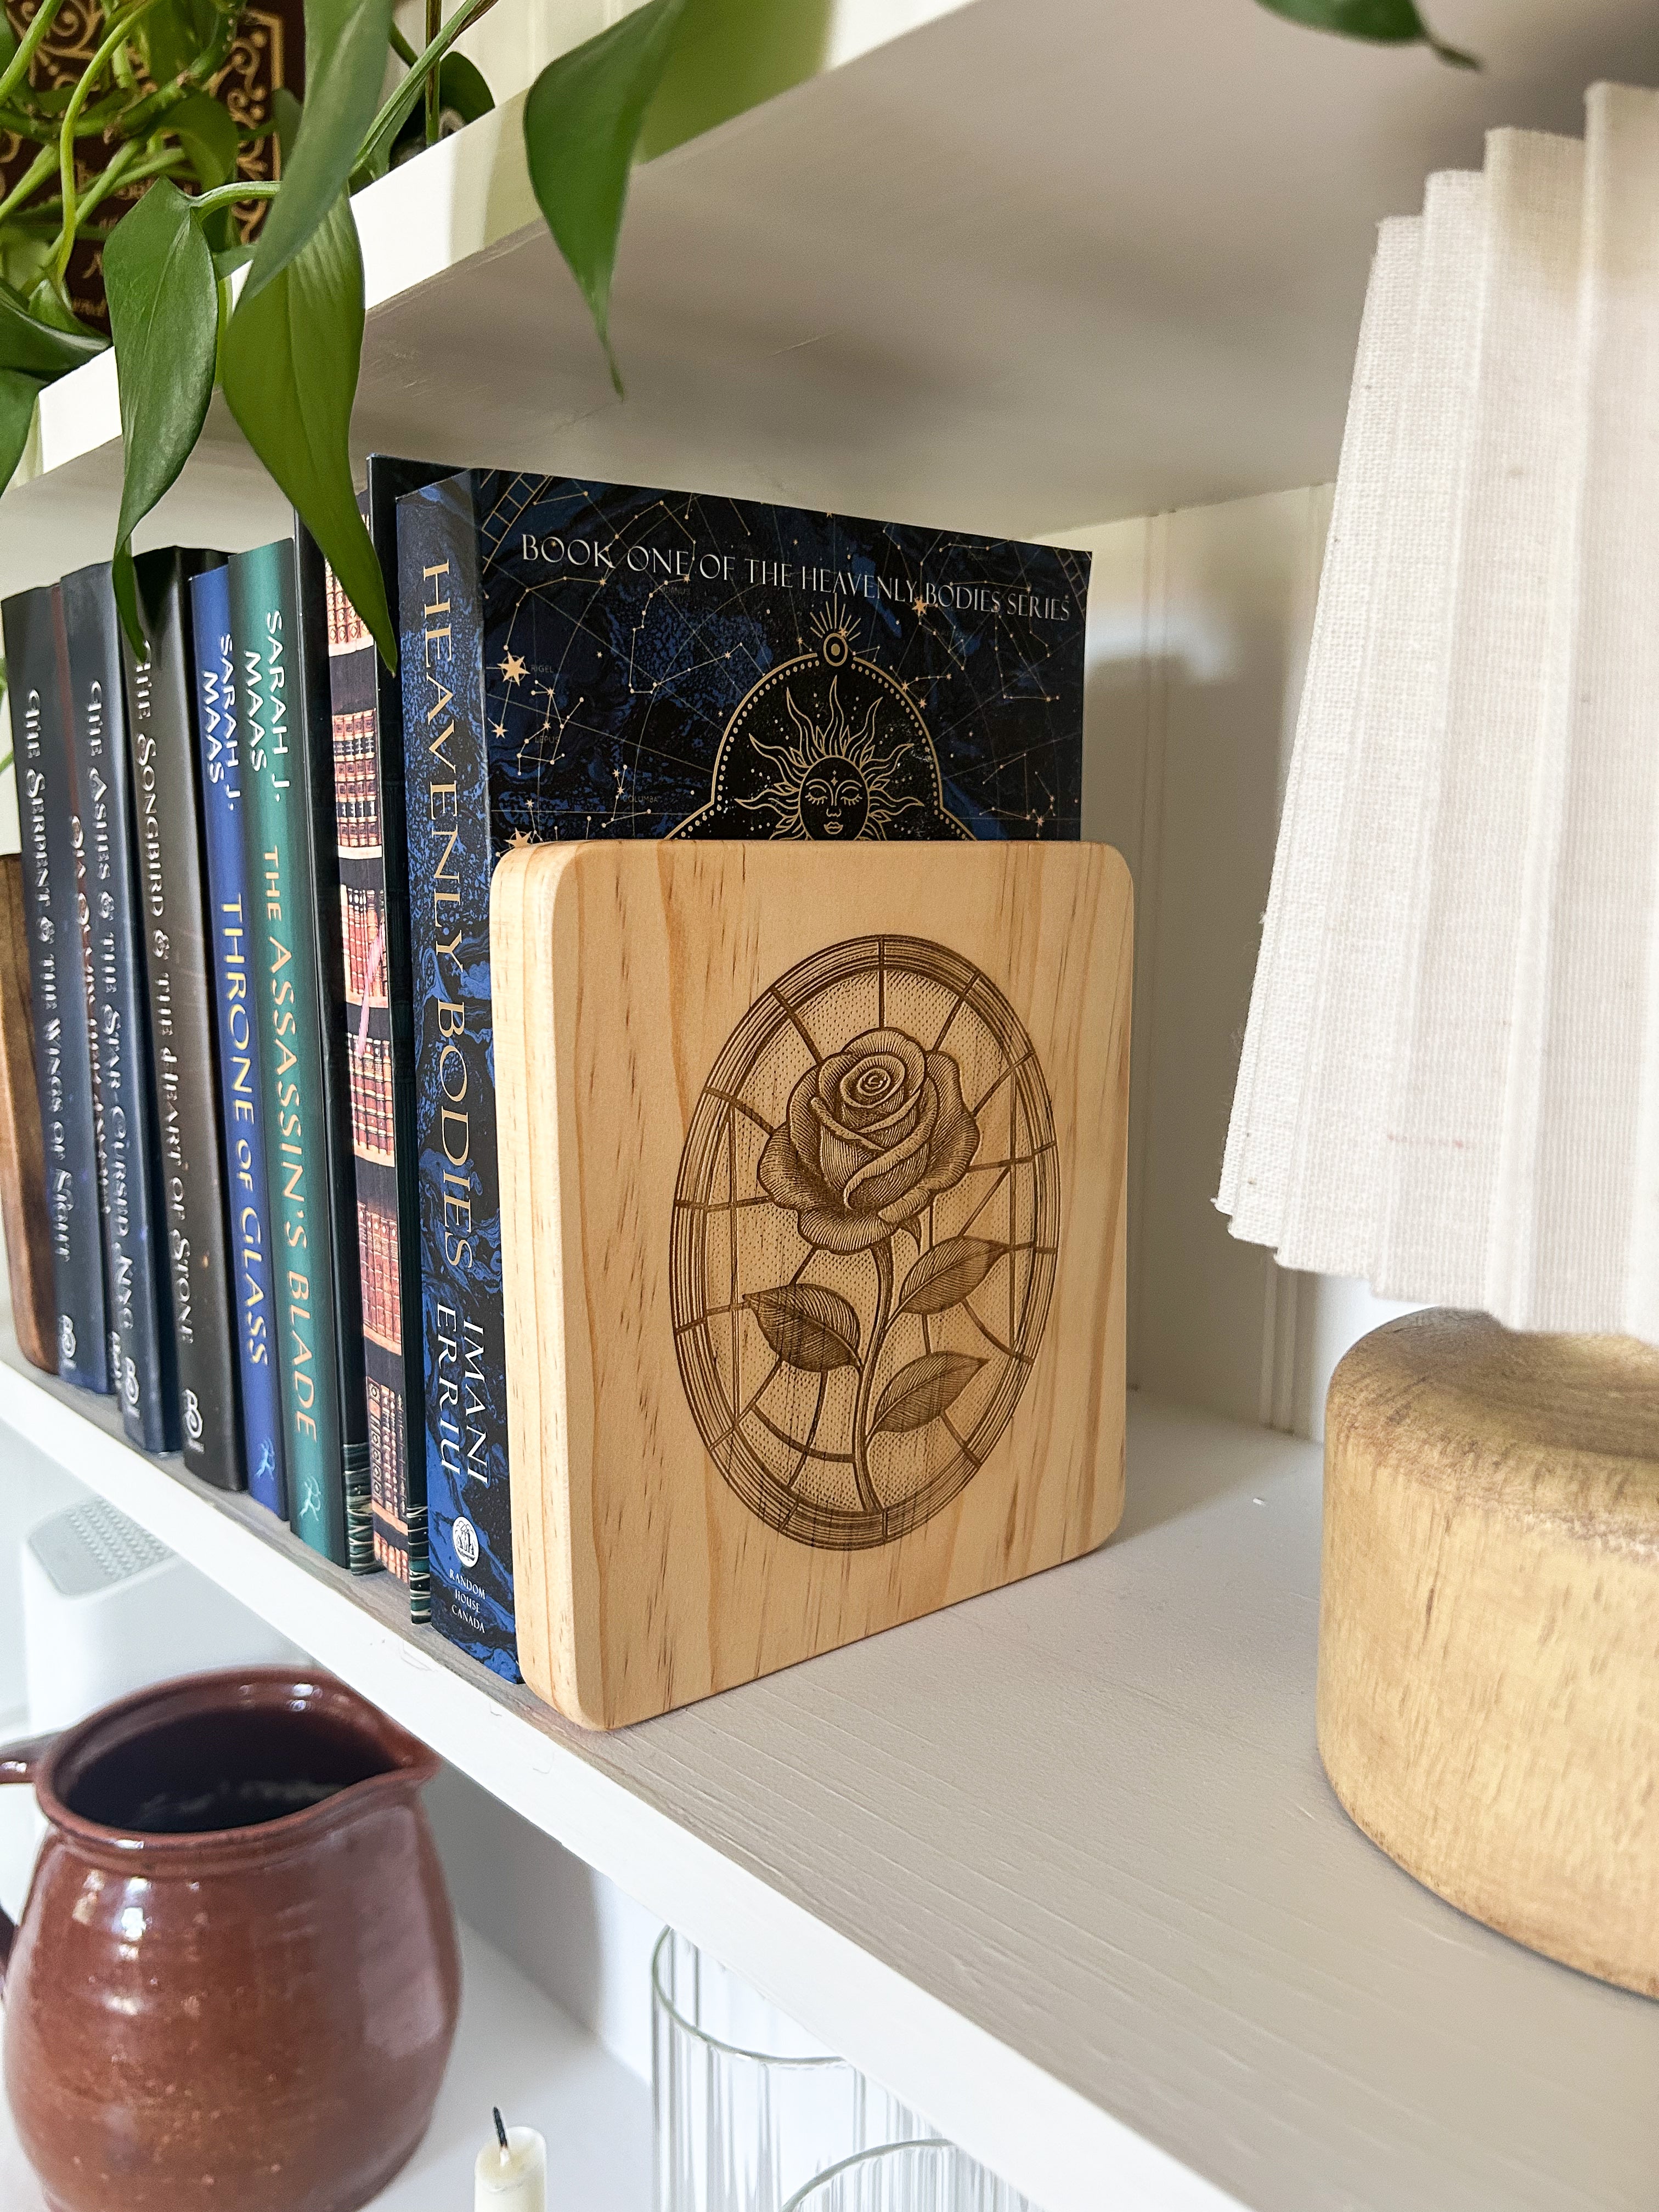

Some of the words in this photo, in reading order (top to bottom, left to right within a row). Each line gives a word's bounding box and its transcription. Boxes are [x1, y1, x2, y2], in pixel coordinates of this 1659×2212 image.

[522, 533, 616, 569] BOOK
[626, 545, 691, 577] ONE
[699, 552, 736, 580] OF
[743, 557, 793, 589] THE
[801, 566, 917, 602] HEAVENLY
[924, 582, 1002, 614] BODIES
[1006, 592, 1072, 622] SERIES
[135, 640, 151, 720] HE
[202, 670, 224, 783] MAAS
[220, 633, 240, 768] SARAH
[244, 650, 268, 772] MAAS
[267, 610, 290, 755] SARAH
[137, 733, 165, 916] SONGBIRD
[225, 784, 241, 811] J.
[272, 773, 290, 802] J.
[422, 558, 464, 974] HEAVENLY
[263, 844, 283, 922] THE
[153, 929, 170, 960] &
[221, 891, 256, 1125] THRONE
[268, 936, 308, 1249] ASSASSIN'S
[437, 997, 473, 1269] BODIES
[236, 1138, 253, 1192] OF
[241, 1206, 269, 1366] GLASS
[287, 1269, 318, 1443] BLADE
[437, 1302, 461, 1476] ERRIU
[463, 1318, 488, 1484] IMANI
[449, 1568, 486, 1600] RANDOM
[452, 1604, 485, 1633] CANADA
[455, 1588, 481, 1614] HOUSE
